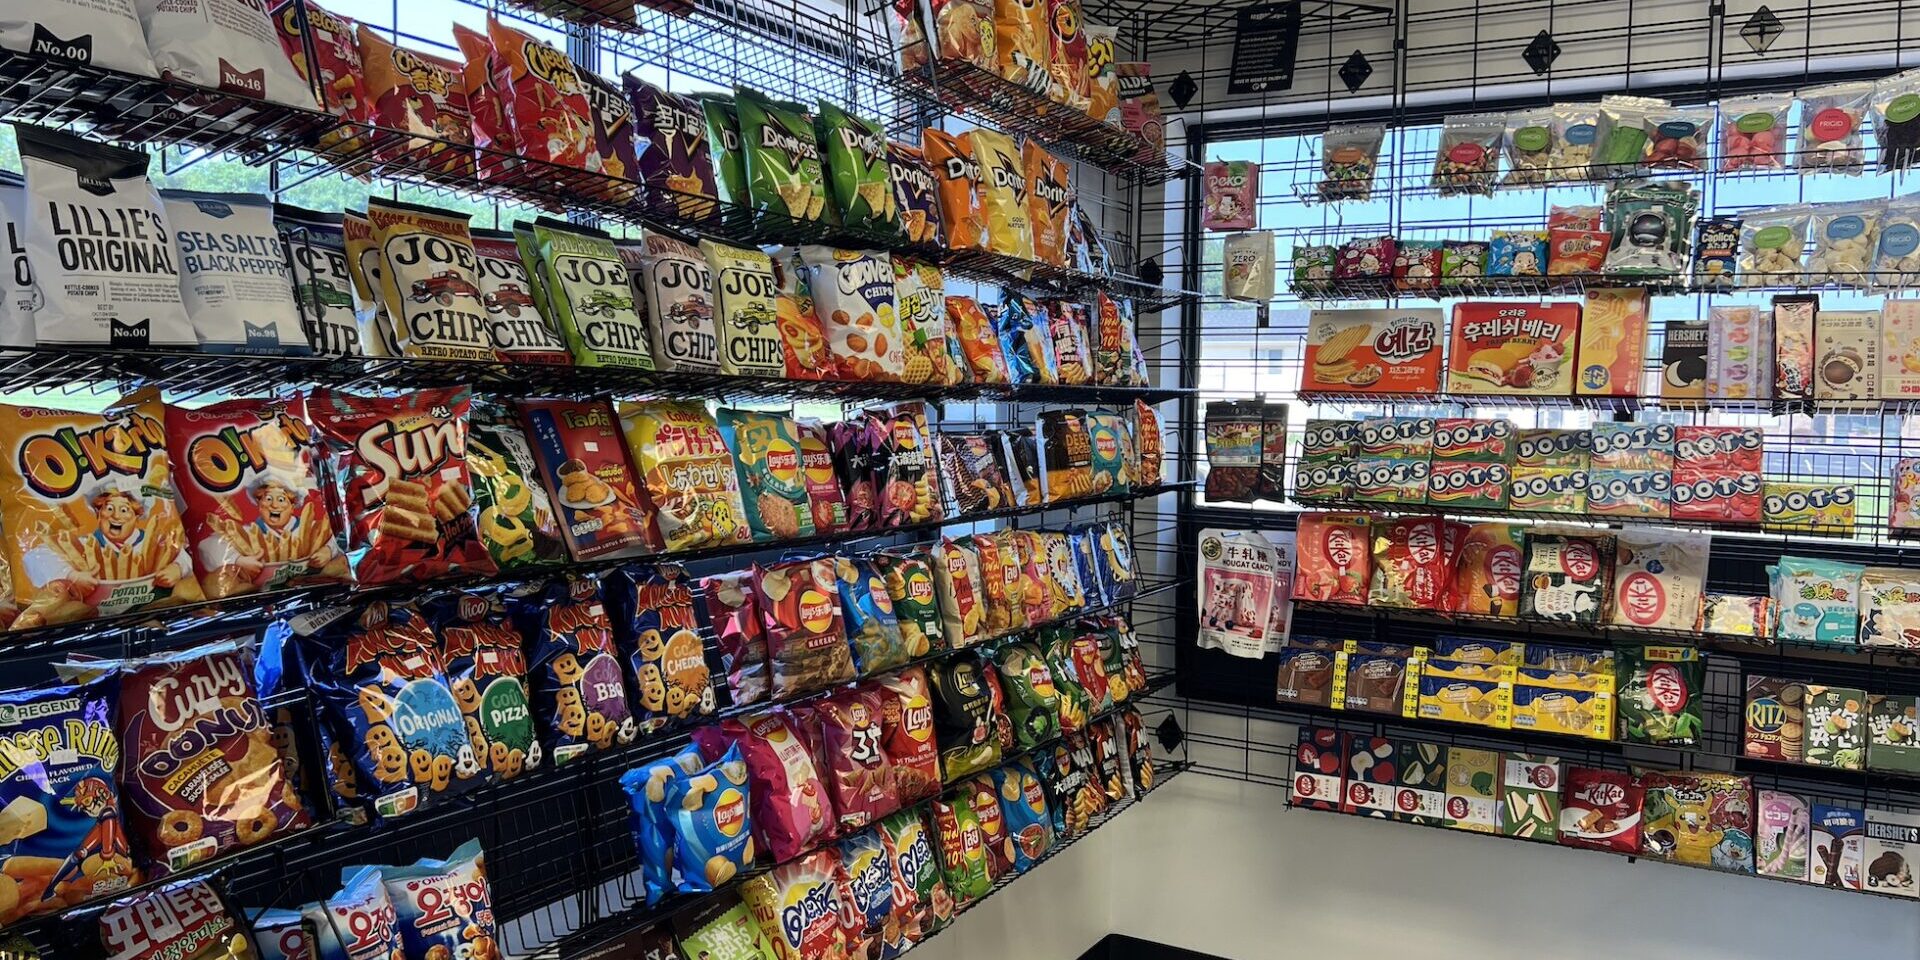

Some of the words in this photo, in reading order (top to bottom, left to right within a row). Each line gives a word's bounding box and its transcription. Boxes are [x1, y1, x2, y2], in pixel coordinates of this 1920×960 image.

[36, 39, 88, 62] No.00
[224, 70, 262, 93] No.16
[1818, 119, 1845, 128] FRIGID
[49, 201, 169, 244] LILLIE'S
[57, 237, 178, 276] ORIGINAL
[176, 230, 223, 255] SEA
[222, 232, 269, 257] SALT
[269, 237, 282, 258] &
[395, 236, 476, 271] JOE
[185, 254, 240, 275] BLACK
[1232, 253, 1256, 264] ZERO
[563, 259, 629, 288] JOE
[725, 271, 775, 298] JOE
[863, 285, 894, 299] CHIPS
[1499, 308, 1527, 317] 오리온
[113, 327, 147, 338] No.00
[410, 309, 494, 346] CHIPS
[1375, 323, 1434, 354] 예감
[1462, 318, 1563, 343] 후레쉬베리
[730, 336, 784, 364] CHIPS
[1364, 418, 1434, 445] DOTS
[1434, 419, 1508, 448] DOTS
[1517, 429, 1591, 459] DOTS
[1593, 424, 1674, 455] DOTS
[1675, 426, 1762, 462] DOTS
[357, 418, 465, 506] Sun
[1357, 461, 1430, 488] DOTS
[1429, 463, 1508, 491] DOTS
[1511, 470, 1589, 501] DOTS
[1588, 470, 1671, 502] DOTS
[1671, 470, 1763, 504] DOTS
[1764, 484, 1855, 516] DOTS
[1328, 527, 1352, 566] KitKat
[1408, 523, 1438, 565] KitKat
[1222, 559, 1250, 568] NOUGAT
[1492, 550, 1521, 592] KitKat
[1566, 543, 1593, 576] KitKat
[100, 595, 132, 608] MASTER
[110, 584, 149, 598] POTATO
[309, 615, 326, 631] BIEN
[460, 601, 485, 618] Vico
[148, 655, 247, 733] Curly
[593, 680, 625, 702] BBQ
[1652, 670, 1682, 707] KitKat
[1826, 692, 1840, 701] RITZ
[18, 699, 80, 720] REGENT
[399, 706, 462, 737] ORIGINAL
[490, 704, 530, 728] PIZZA
[906, 705, 932, 732] Lay's
[1748, 703, 1786, 728] RITZ
[49, 763, 94, 778] FLAVORED
[1587, 782, 1626, 806] KitKat
